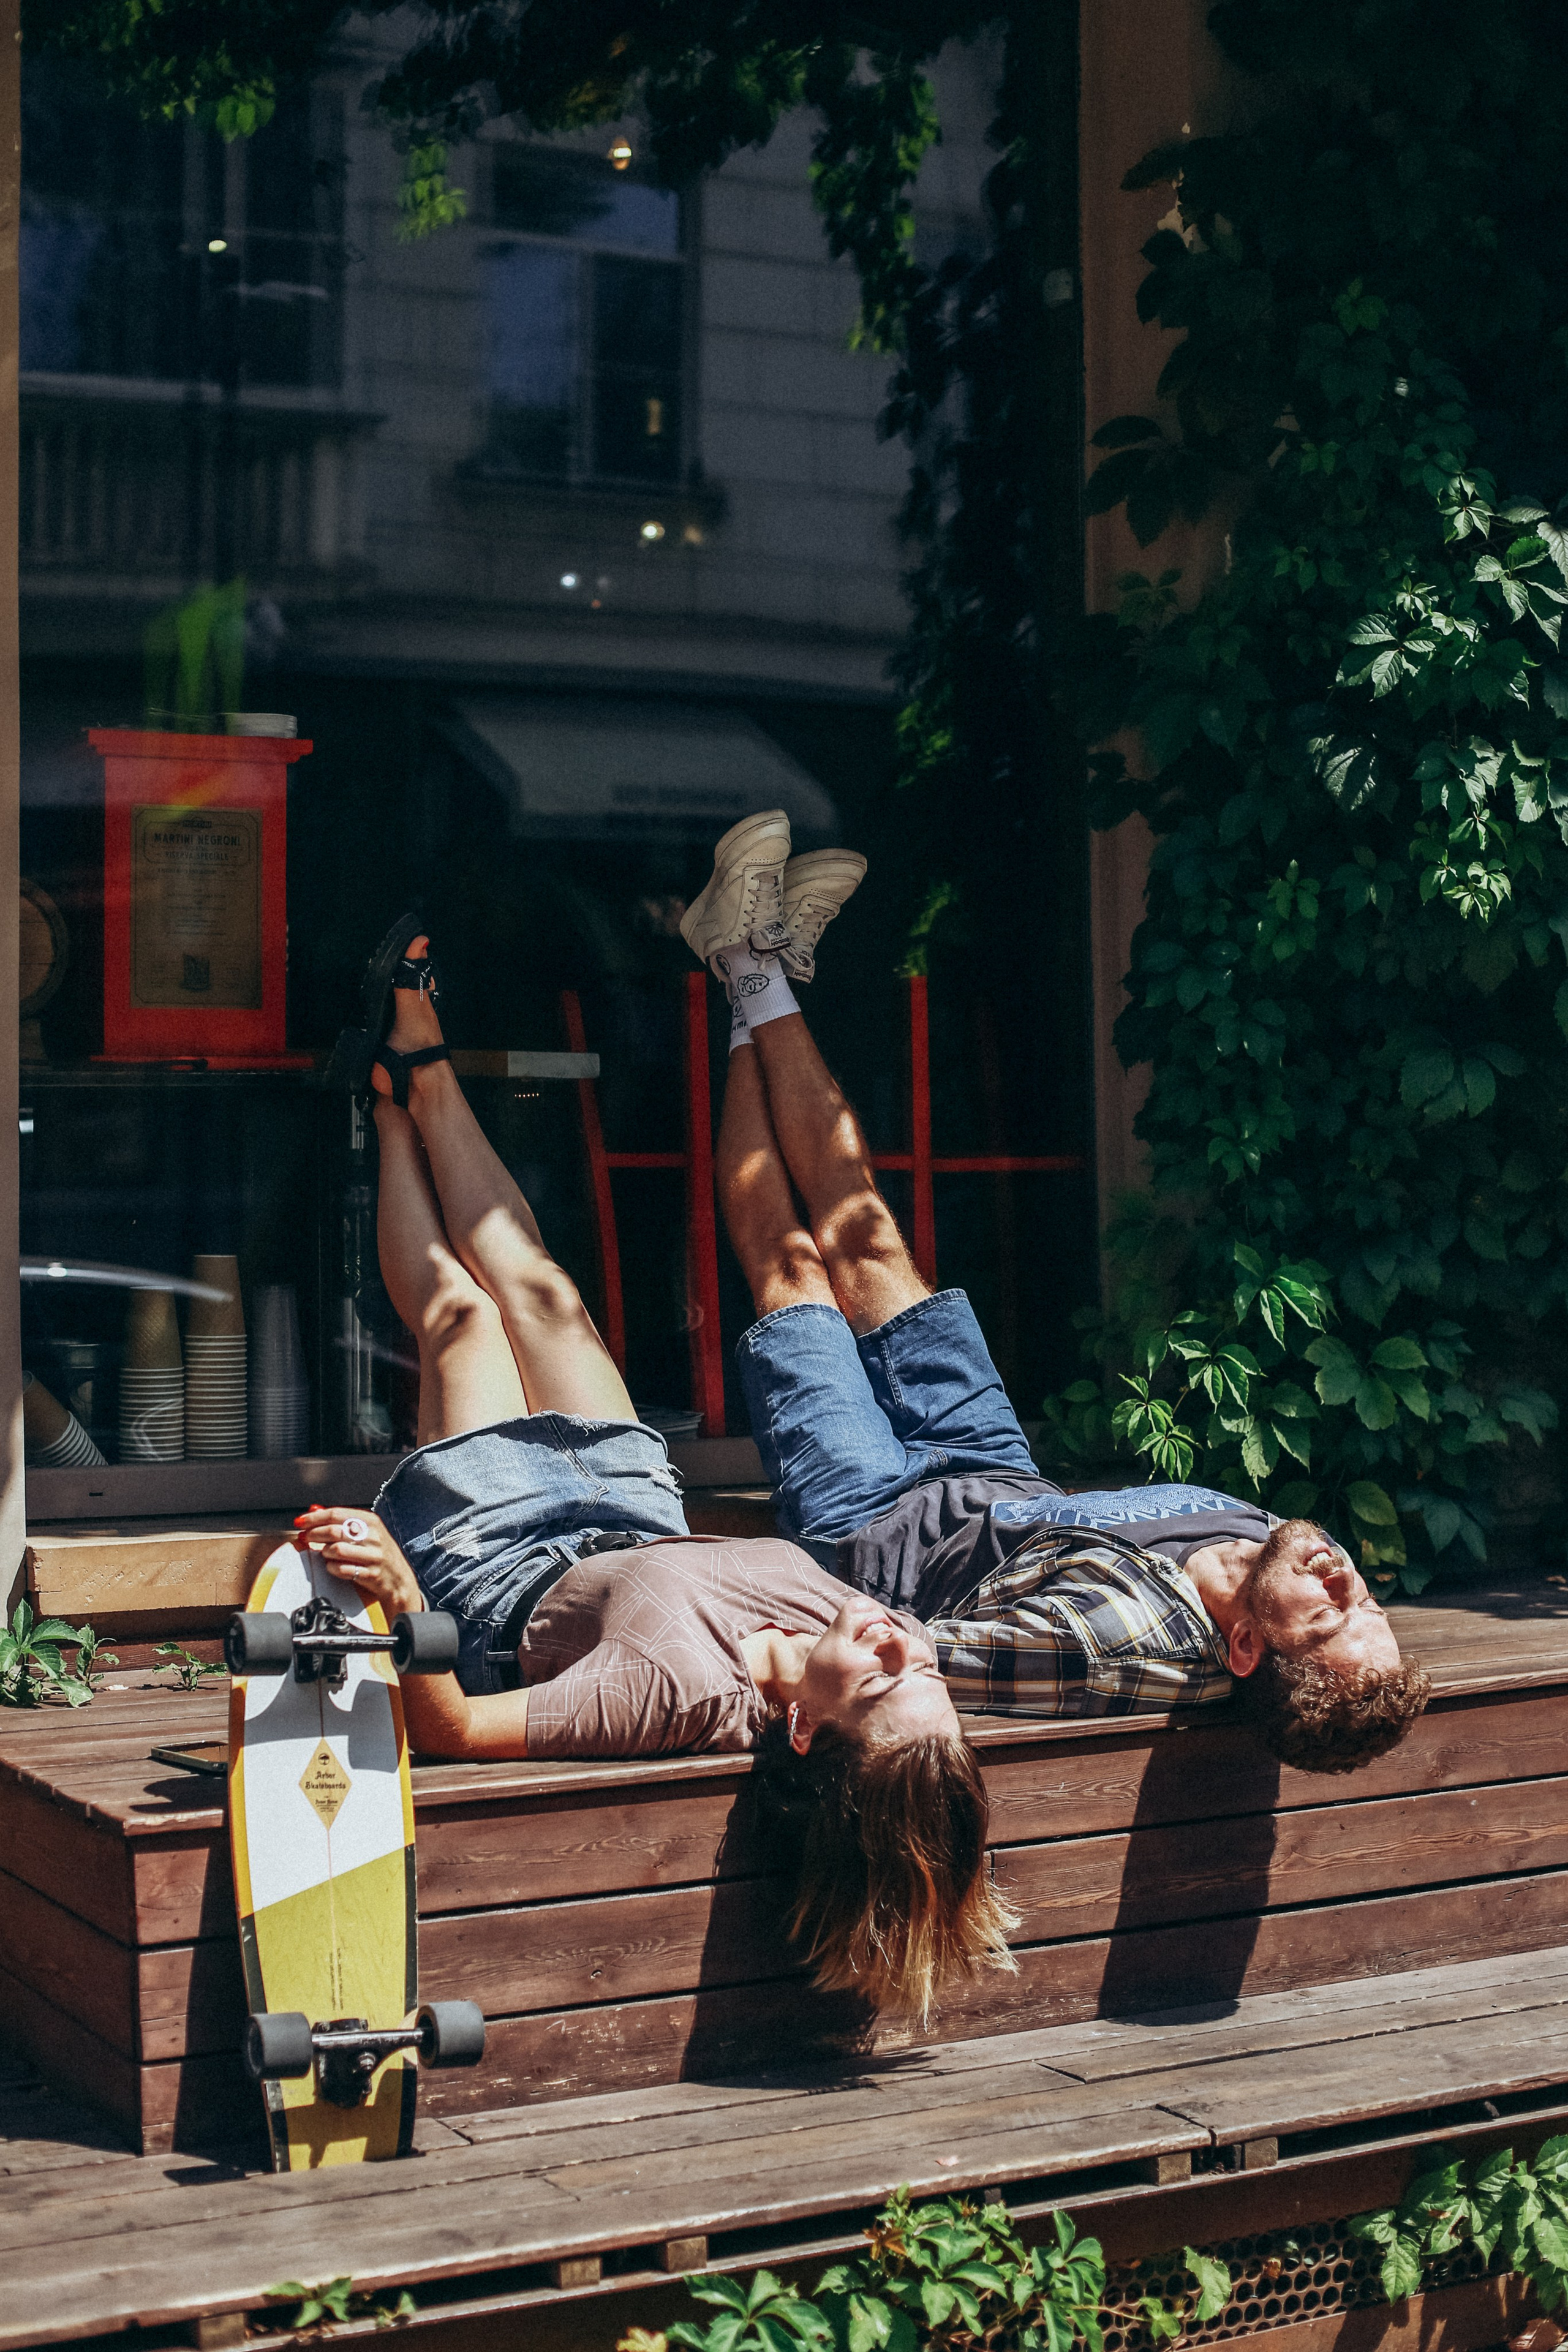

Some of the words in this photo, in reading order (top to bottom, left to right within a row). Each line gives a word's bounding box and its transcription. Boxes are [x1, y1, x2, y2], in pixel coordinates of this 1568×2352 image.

[154, 833, 193, 845] MARTINI
[198, 835, 241, 846] NEGRONI
[771, 937, 790, 947] Reebok
[794, 971, 812, 981] Reebok
[315, 1771, 336, 1779] Arbor
[305, 1781, 346, 1790] Skateboards
